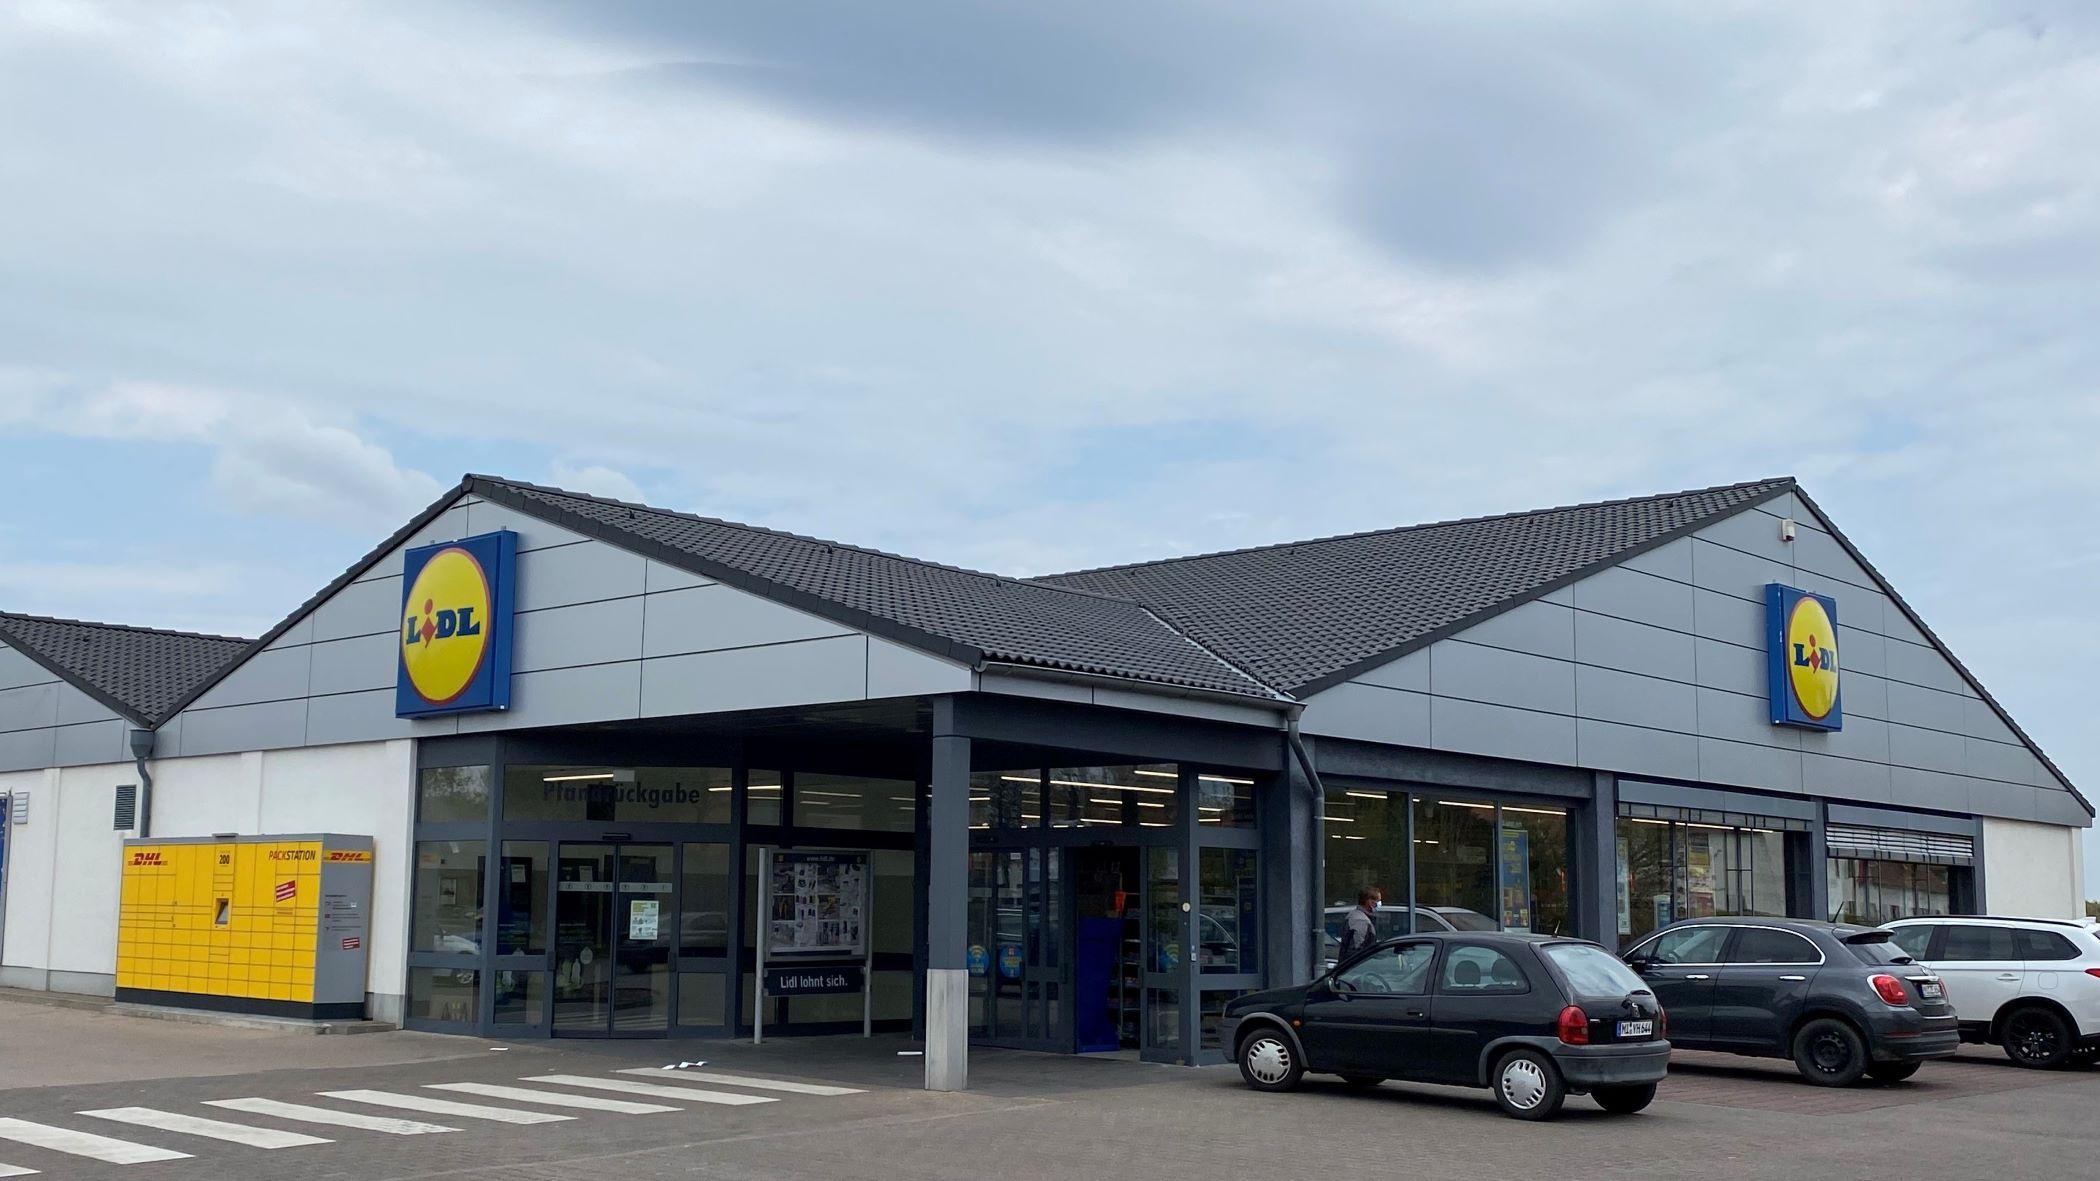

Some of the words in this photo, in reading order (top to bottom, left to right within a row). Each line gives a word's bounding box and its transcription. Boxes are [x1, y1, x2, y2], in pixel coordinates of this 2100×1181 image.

[406, 598, 480, 648] LIDL
[1793, 634, 1837, 674] LIDL
[543, 781, 700, 809] Pfanückgabe
[133, 852, 162, 866] DHL
[219, 854, 230, 865] 200
[268, 849, 317, 861] PACKSTATION
[330, 852, 364, 861] DHL
[780, 975, 798, 989] Lidl
[800, 975, 824, 988] lohnt
[826, 974, 848, 987] sich.
